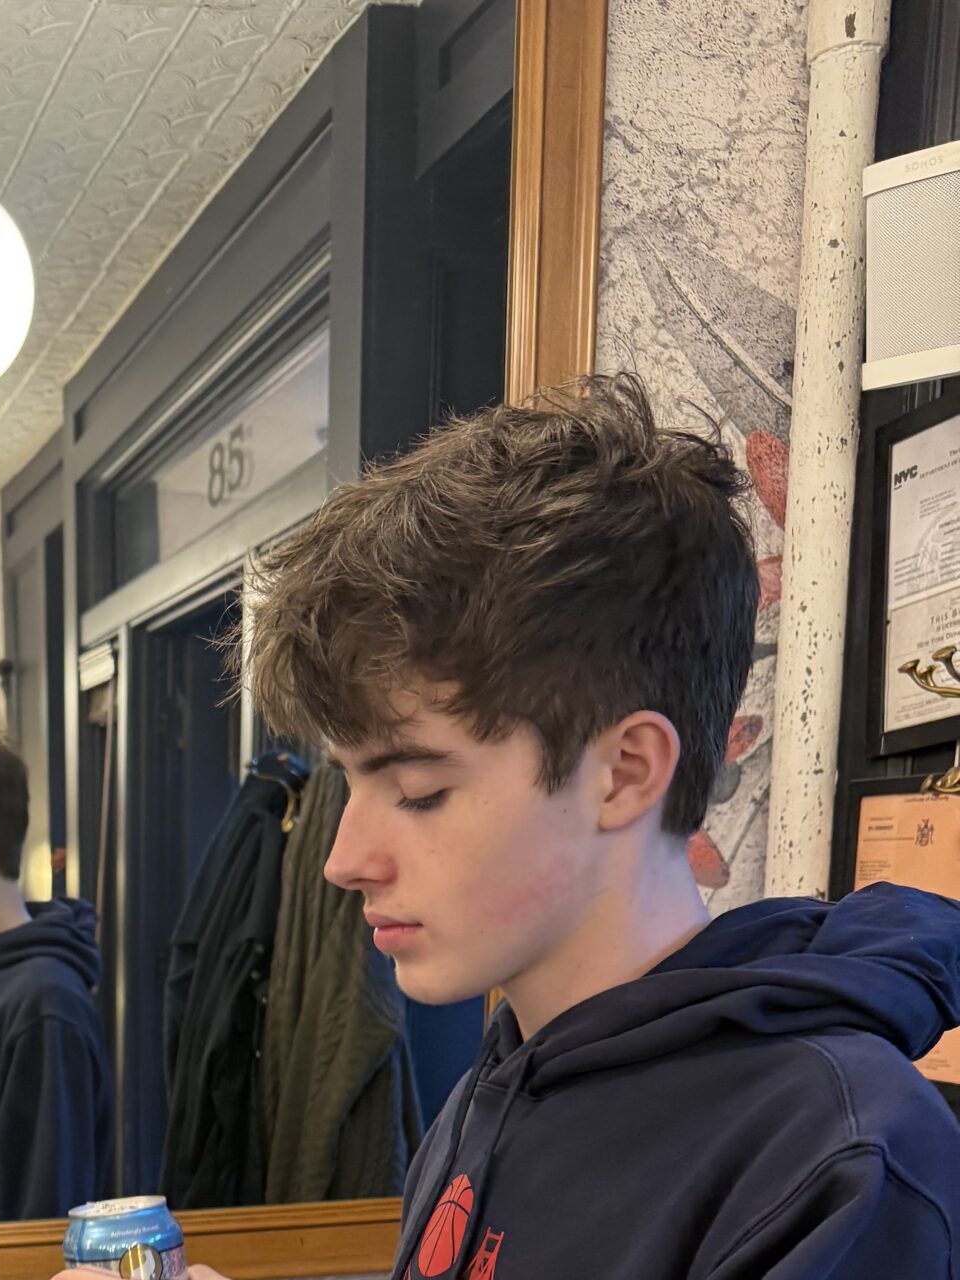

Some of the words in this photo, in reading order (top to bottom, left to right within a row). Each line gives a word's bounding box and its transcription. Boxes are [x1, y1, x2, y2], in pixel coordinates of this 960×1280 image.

[904, 155, 944, 173] SONOS
[207, 422, 246, 508] 85
[894, 464, 918, 486] NYC
[930, 611, 948, 625] THIS
